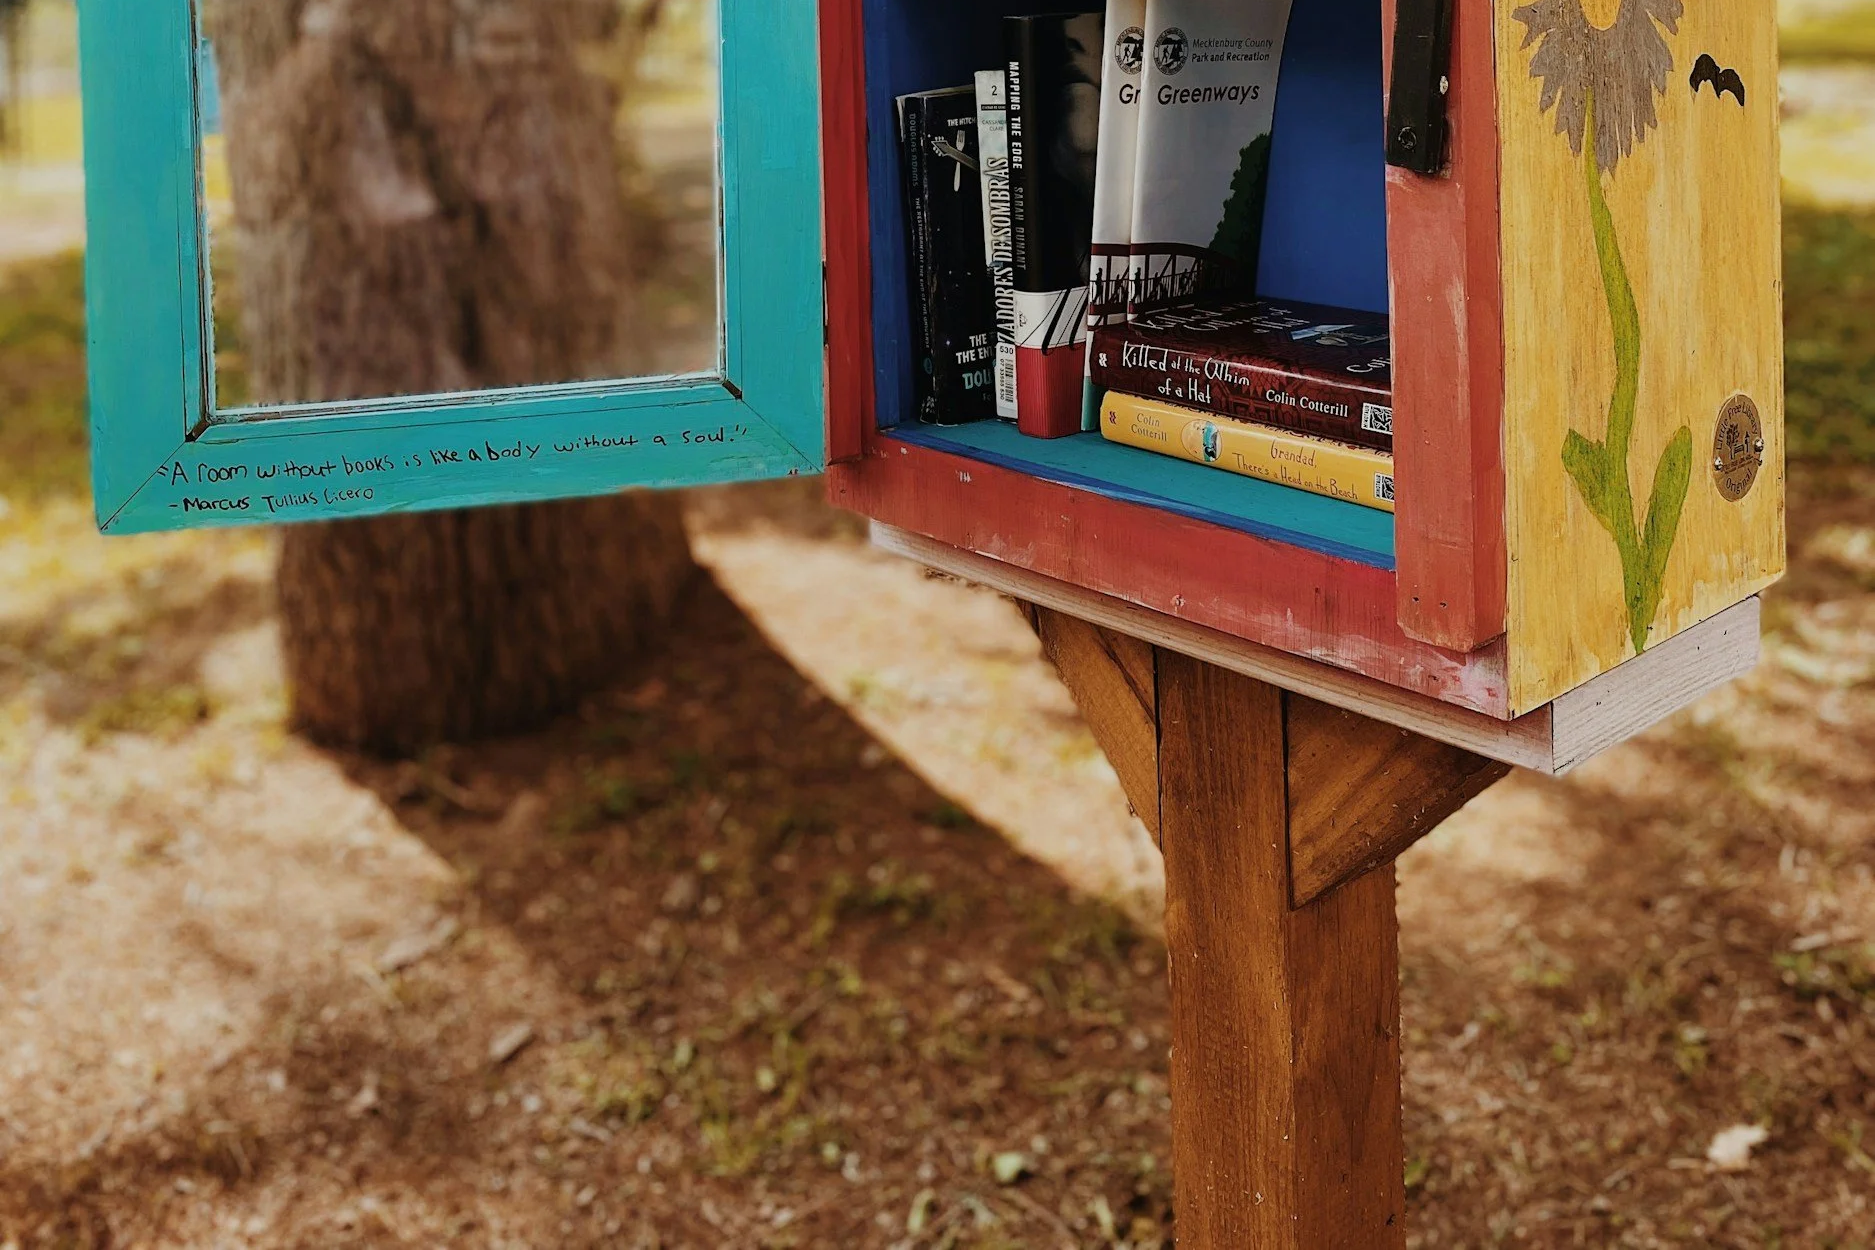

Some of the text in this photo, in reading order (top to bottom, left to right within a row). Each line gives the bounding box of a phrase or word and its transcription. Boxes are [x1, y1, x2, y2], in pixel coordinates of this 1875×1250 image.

[1192, 37, 1273, 51] Mecklenburg County
[1191, 51, 1270, 63] Park and Recreation
[991, 85, 998, 96] 2
[1157, 82, 1260, 106] Greenways
[947, 118, 959, 127] THE
[1008, 61, 1024, 170] MAPPING THE EDGE
[1013, 186, 1026, 222] SARAH
[991, 240, 1012, 262] DE
[969, 333, 988, 348] THE
[955, 349, 976, 365] THE
[1122, 340, 1250, 386] Killed at the Whim
[1158, 378, 1211, 404] of a Hat
[1266, 390, 1349, 418] Colin Cotterill
[1137, 412, 1160, 428] Colin
[1717, 402, 1758, 450] Little Free Library
[1131, 424, 1168, 442] Cotterill
[198, 463, 247, 482] room
[257, 460, 336, 480] without
[342, 454, 395, 475] books
[404, 452, 422, 467] is
[430, 448, 462, 466] like
[469, 448, 482, 462] a
[485, 440, 541, 463] body
[553, 433, 639, 453] without
[653, 434, 667, 447] a
[1271, 440, 1317, 469] Grandad,
[1232, 452, 1358, 500] There's a Head on the Beach
[1725, 468, 1753, 494] Original
[261, 490, 319, 513] Tullius
[324, 488, 374, 505] Cicero
